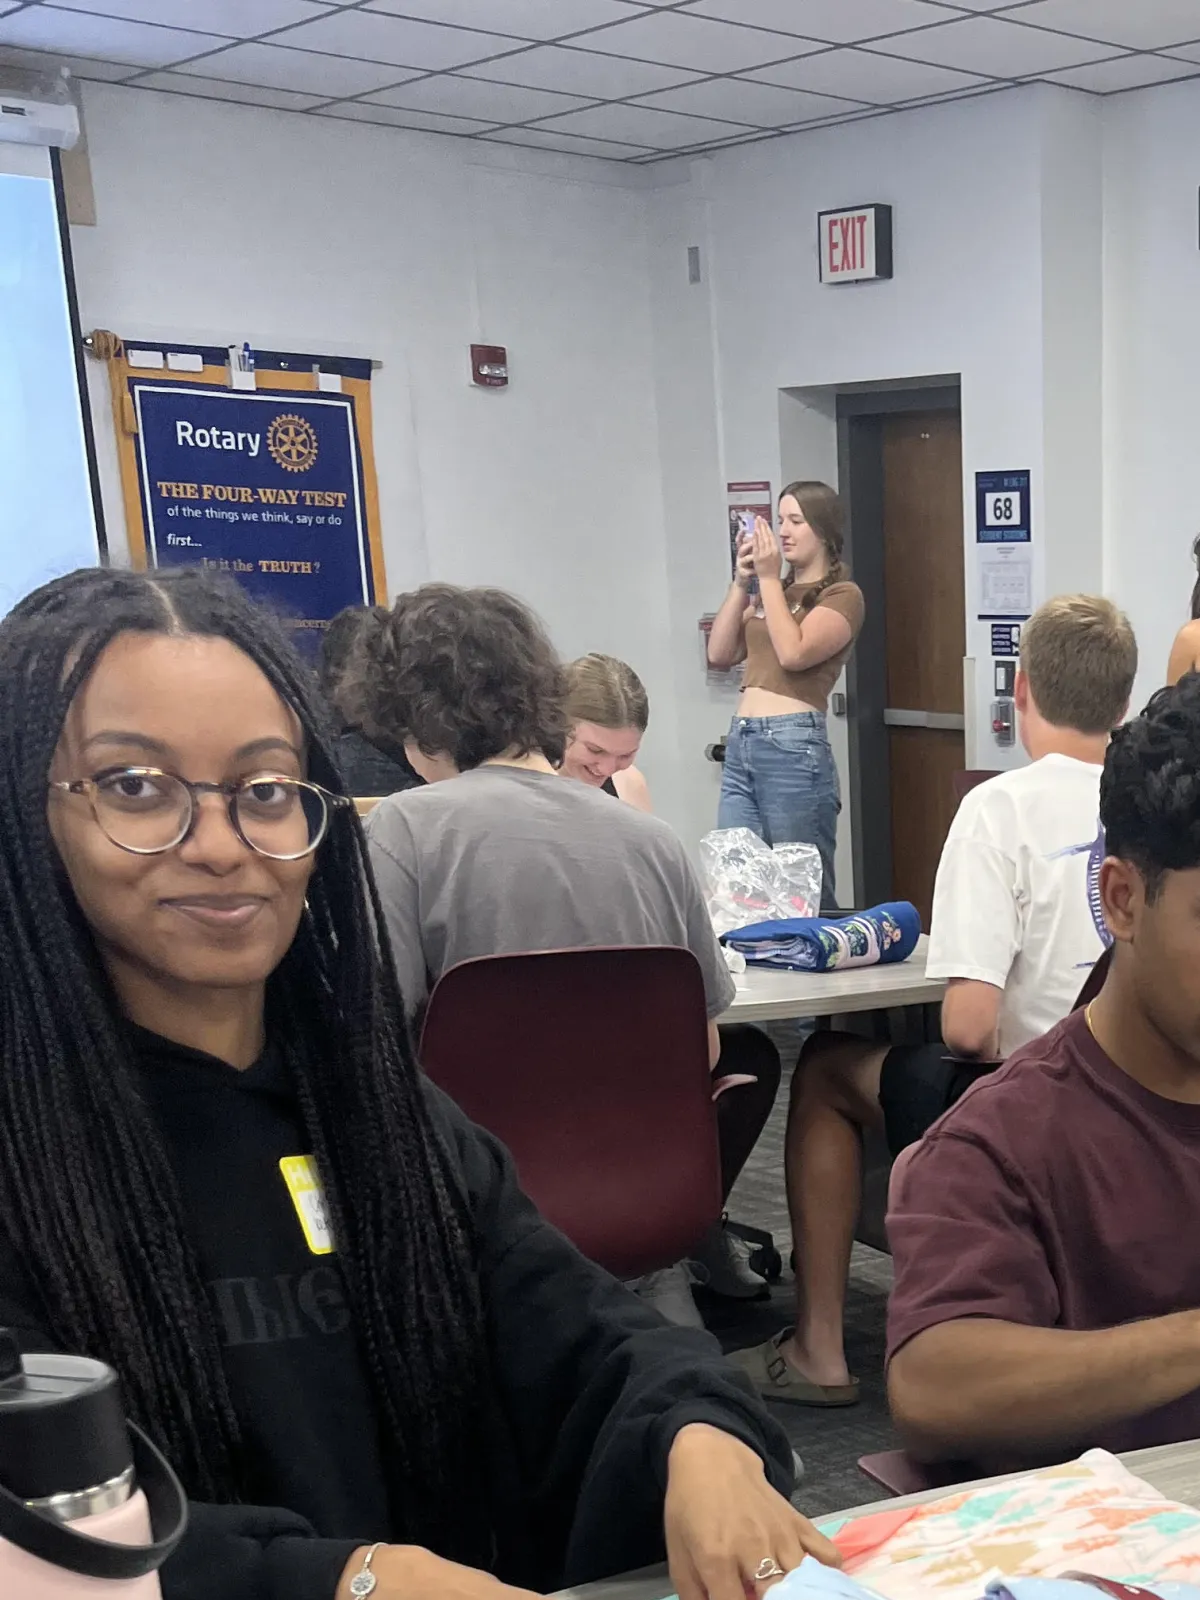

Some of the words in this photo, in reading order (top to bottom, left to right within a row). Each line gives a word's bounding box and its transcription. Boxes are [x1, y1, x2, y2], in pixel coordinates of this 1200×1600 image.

[828, 214, 868, 273] EXIT
[175, 420, 261, 457] Rotary
[156, 481, 198, 500] THE
[201, 483, 298, 506] FOUR-WAY
[302, 488, 347, 508] TEST
[167, 505, 180, 517] of
[182, 506, 202, 518] the
[205, 507, 240, 524] things
[241, 511, 259, 522] we
[262, 509, 294, 525] think,
[296, 514, 314, 527] say
[315, 515, 326, 525] or
[328, 513, 342, 526] do
[993, 497, 1013, 521] 68
[218, 558, 230, 571] it
[232, 559, 253, 572] the
[259, 560, 313, 574] TRUTH
